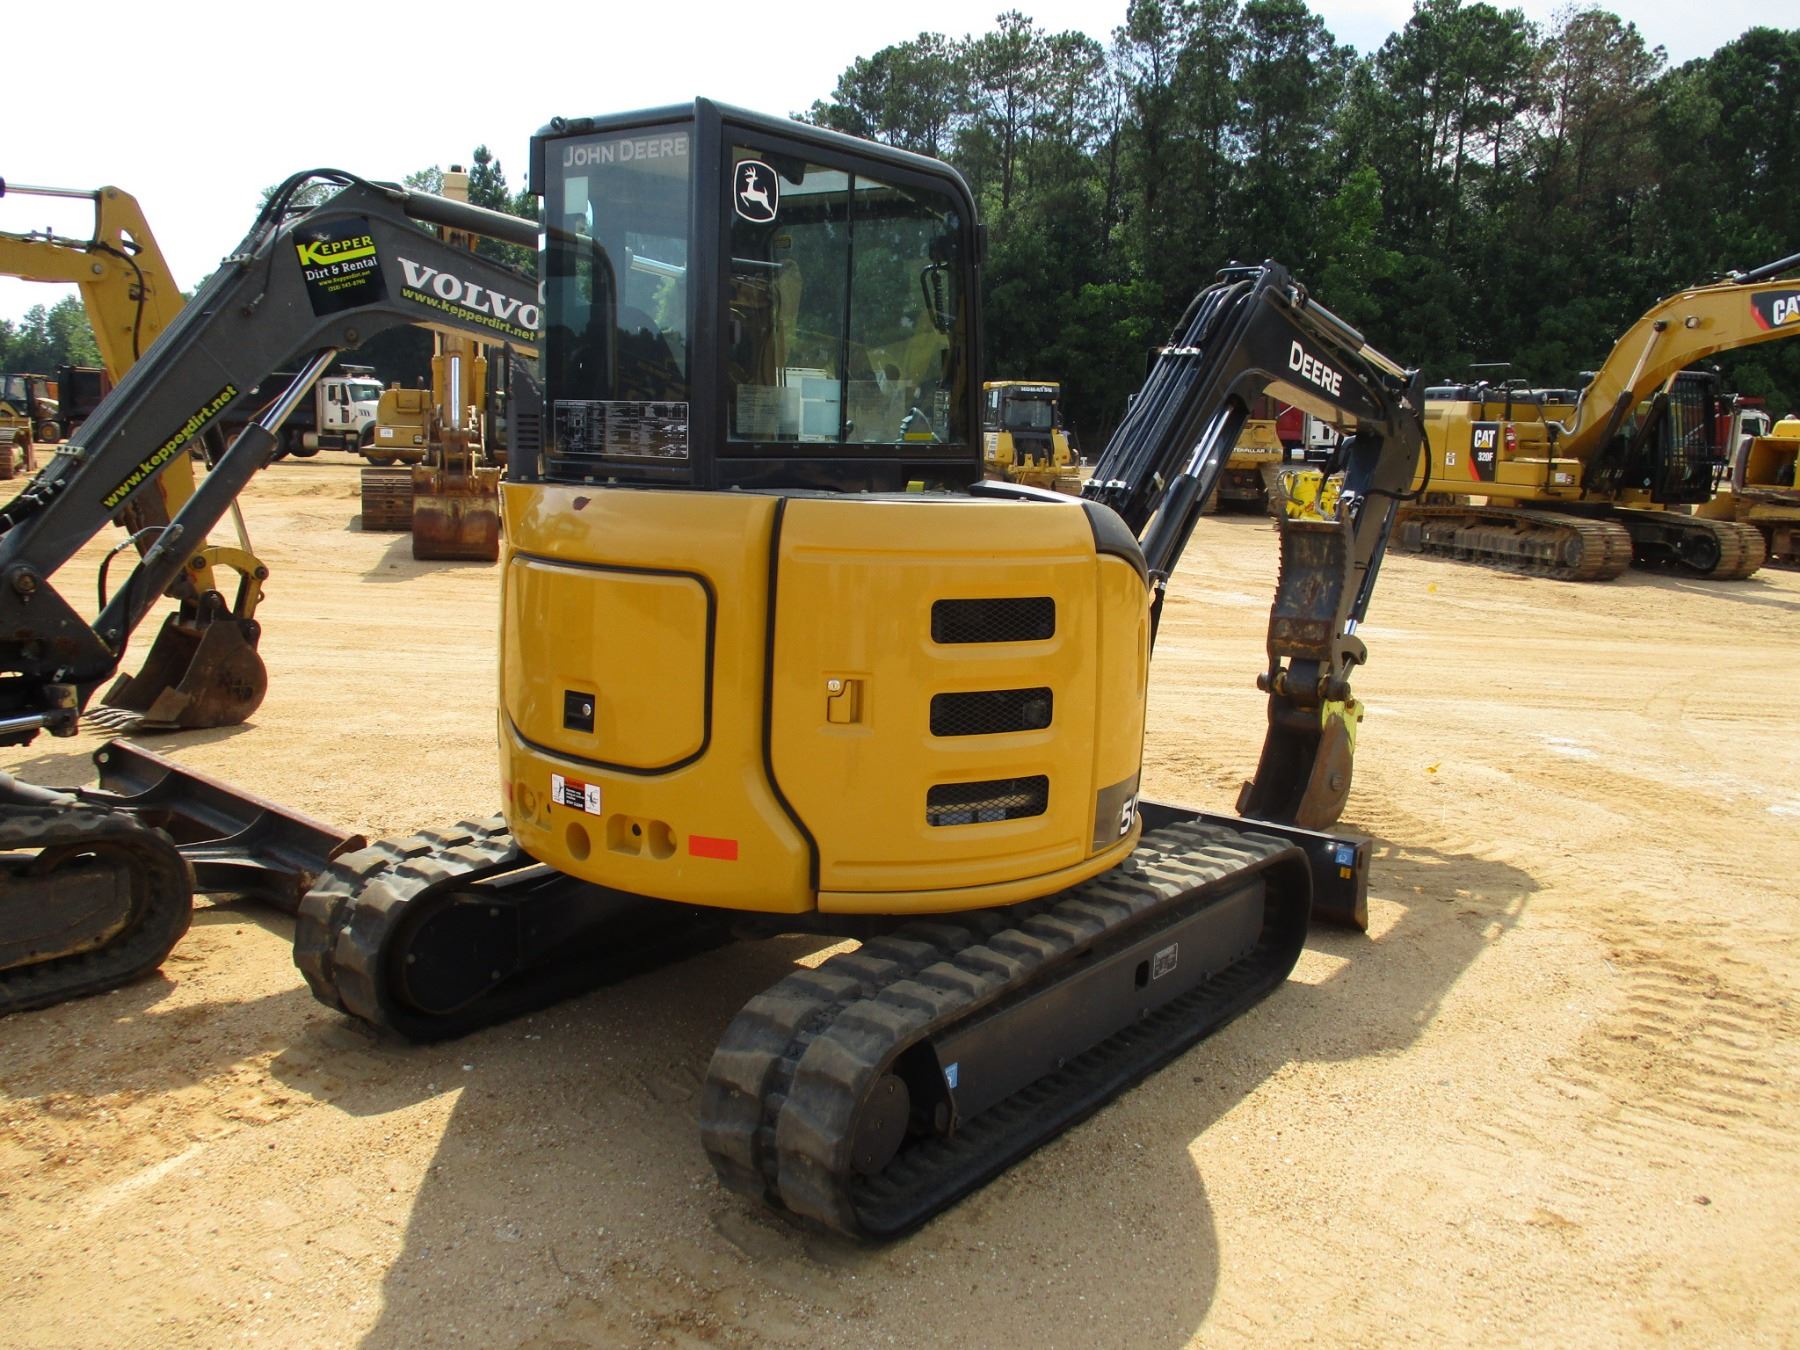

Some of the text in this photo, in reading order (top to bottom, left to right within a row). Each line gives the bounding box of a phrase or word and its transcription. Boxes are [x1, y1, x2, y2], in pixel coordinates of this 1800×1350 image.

[563, 137, 688, 168] JOHN DEERE
[296, 235, 376, 266] KEPPER
[305, 257, 378, 281] Dirt & Rental
[397, 257, 539, 330] VOLVO
[402, 288, 535, 341] www.kepperdirt.net
[1773, 295, 1800, 325] CA
[1289, 340, 1343, 397] DEERE
[103, 385, 238, 507] www.kepperdirt.net
[1474, 429, 1496, 448] CAT
[1477, 452, 1494, 462] 320F
